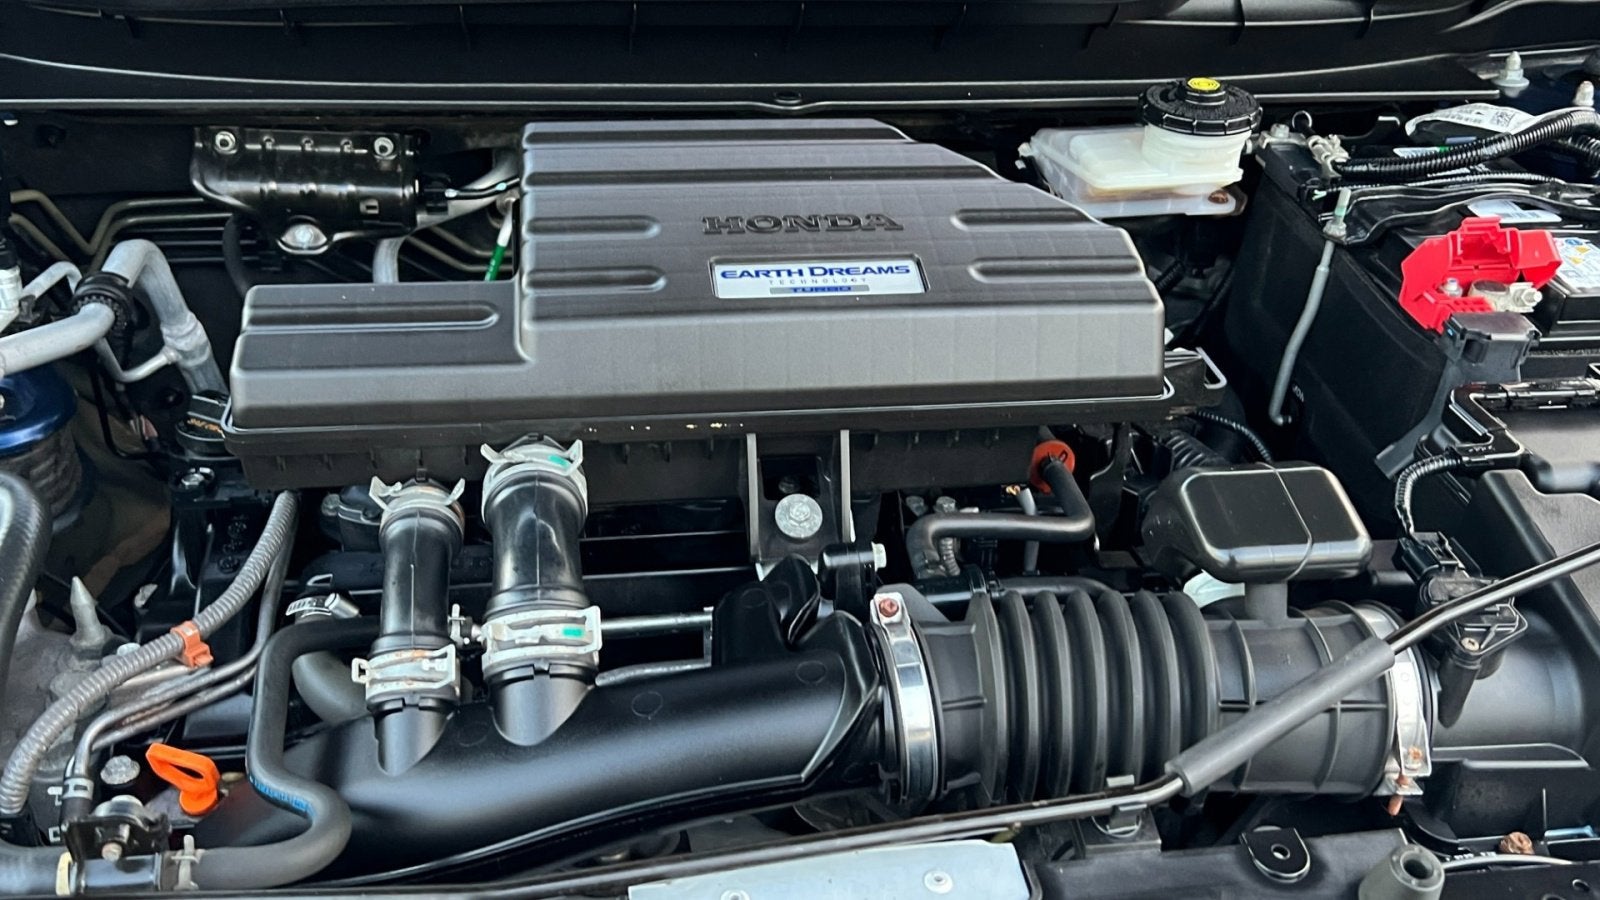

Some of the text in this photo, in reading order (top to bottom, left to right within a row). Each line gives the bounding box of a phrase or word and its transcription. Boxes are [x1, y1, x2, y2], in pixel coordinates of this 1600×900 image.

[702, 213, 904, 234] HONDA
[720, 265, 910, 279] EARTH DREAMS
[769, 277, 867, 285] TECHNOLOGY
